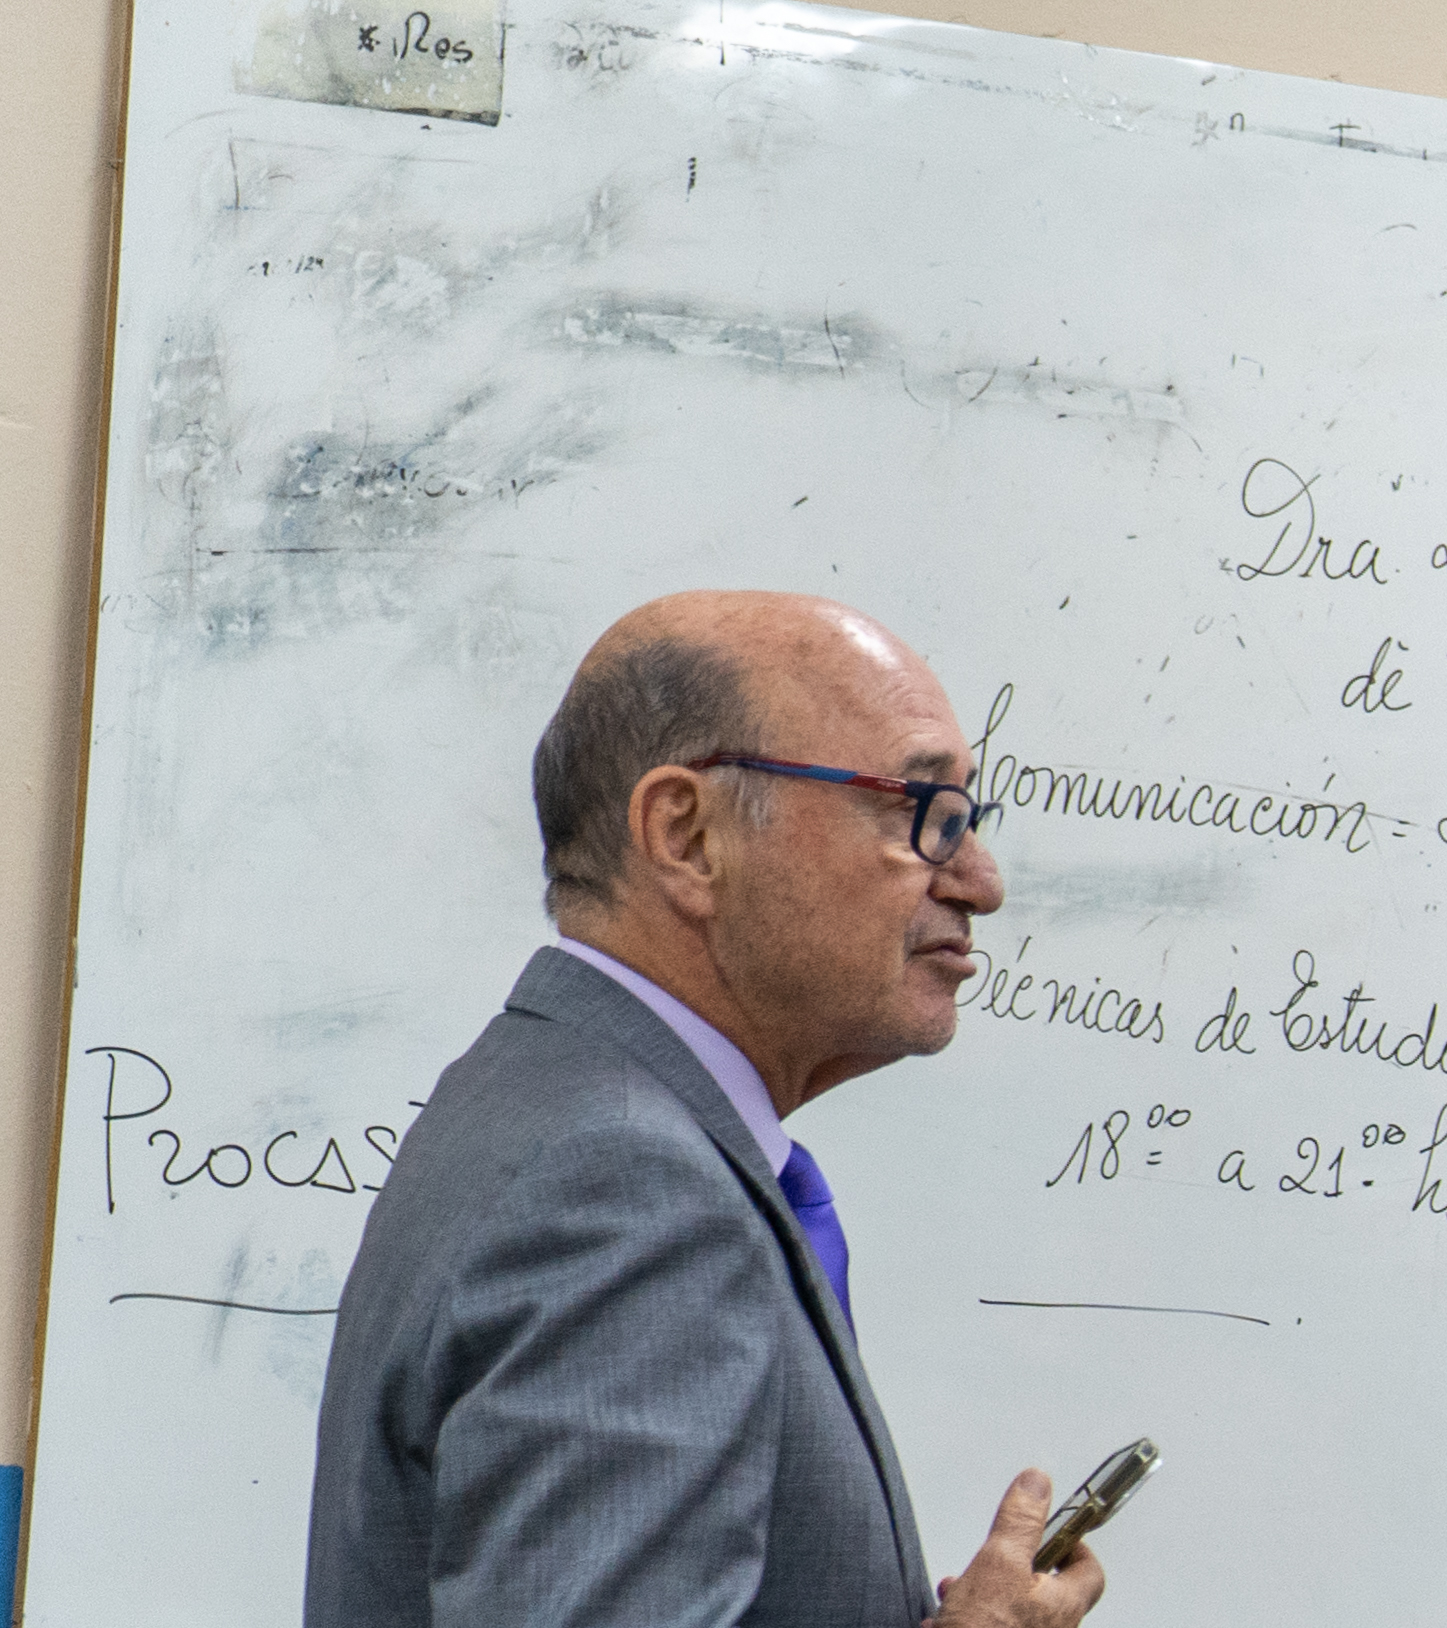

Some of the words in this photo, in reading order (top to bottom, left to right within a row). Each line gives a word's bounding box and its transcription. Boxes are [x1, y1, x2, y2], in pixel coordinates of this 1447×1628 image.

[1340, 636, 1414, 714] de
[1194, 984, 1258, 1056] de
[1217, 1148, 1256, 1192] a
